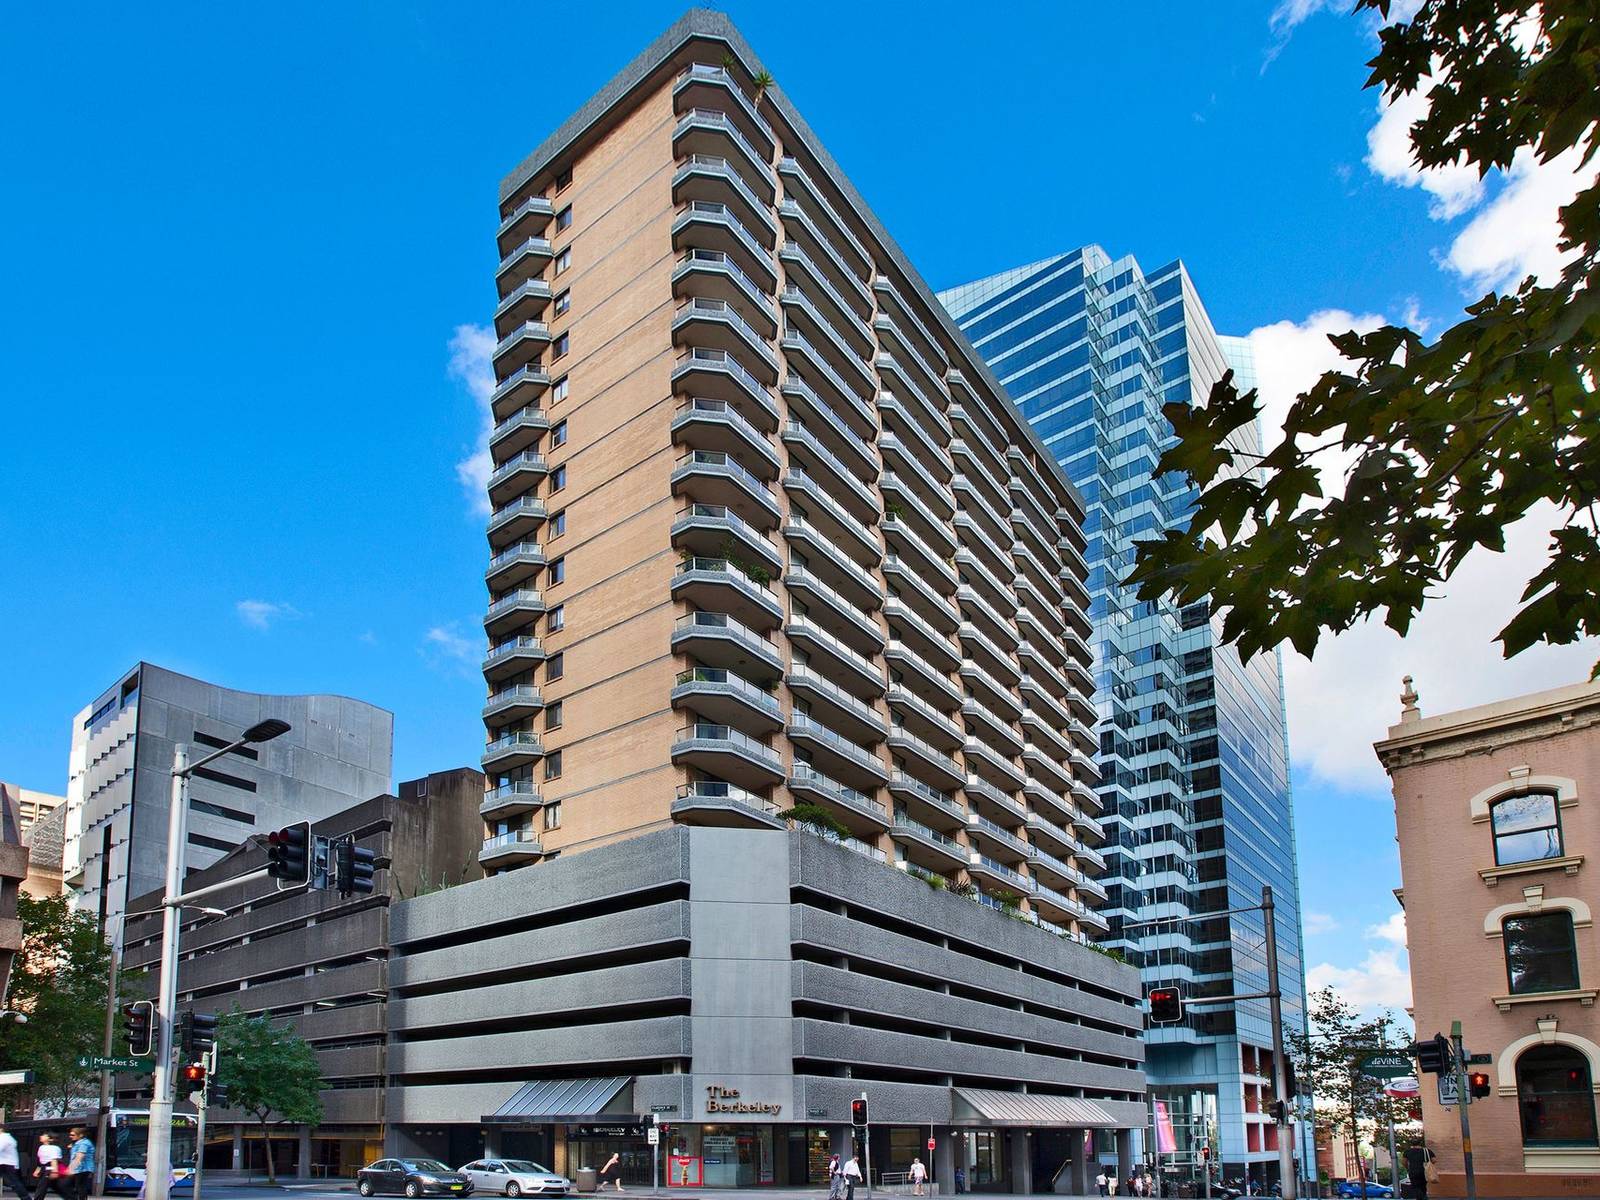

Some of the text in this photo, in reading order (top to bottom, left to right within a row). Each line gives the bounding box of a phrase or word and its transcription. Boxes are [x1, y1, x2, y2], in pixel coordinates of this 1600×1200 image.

[94, 1057, 128, 1066] Market
[706, 1086, 740, 1099] The
[706, 1100, 782, 1116] Berkeley
